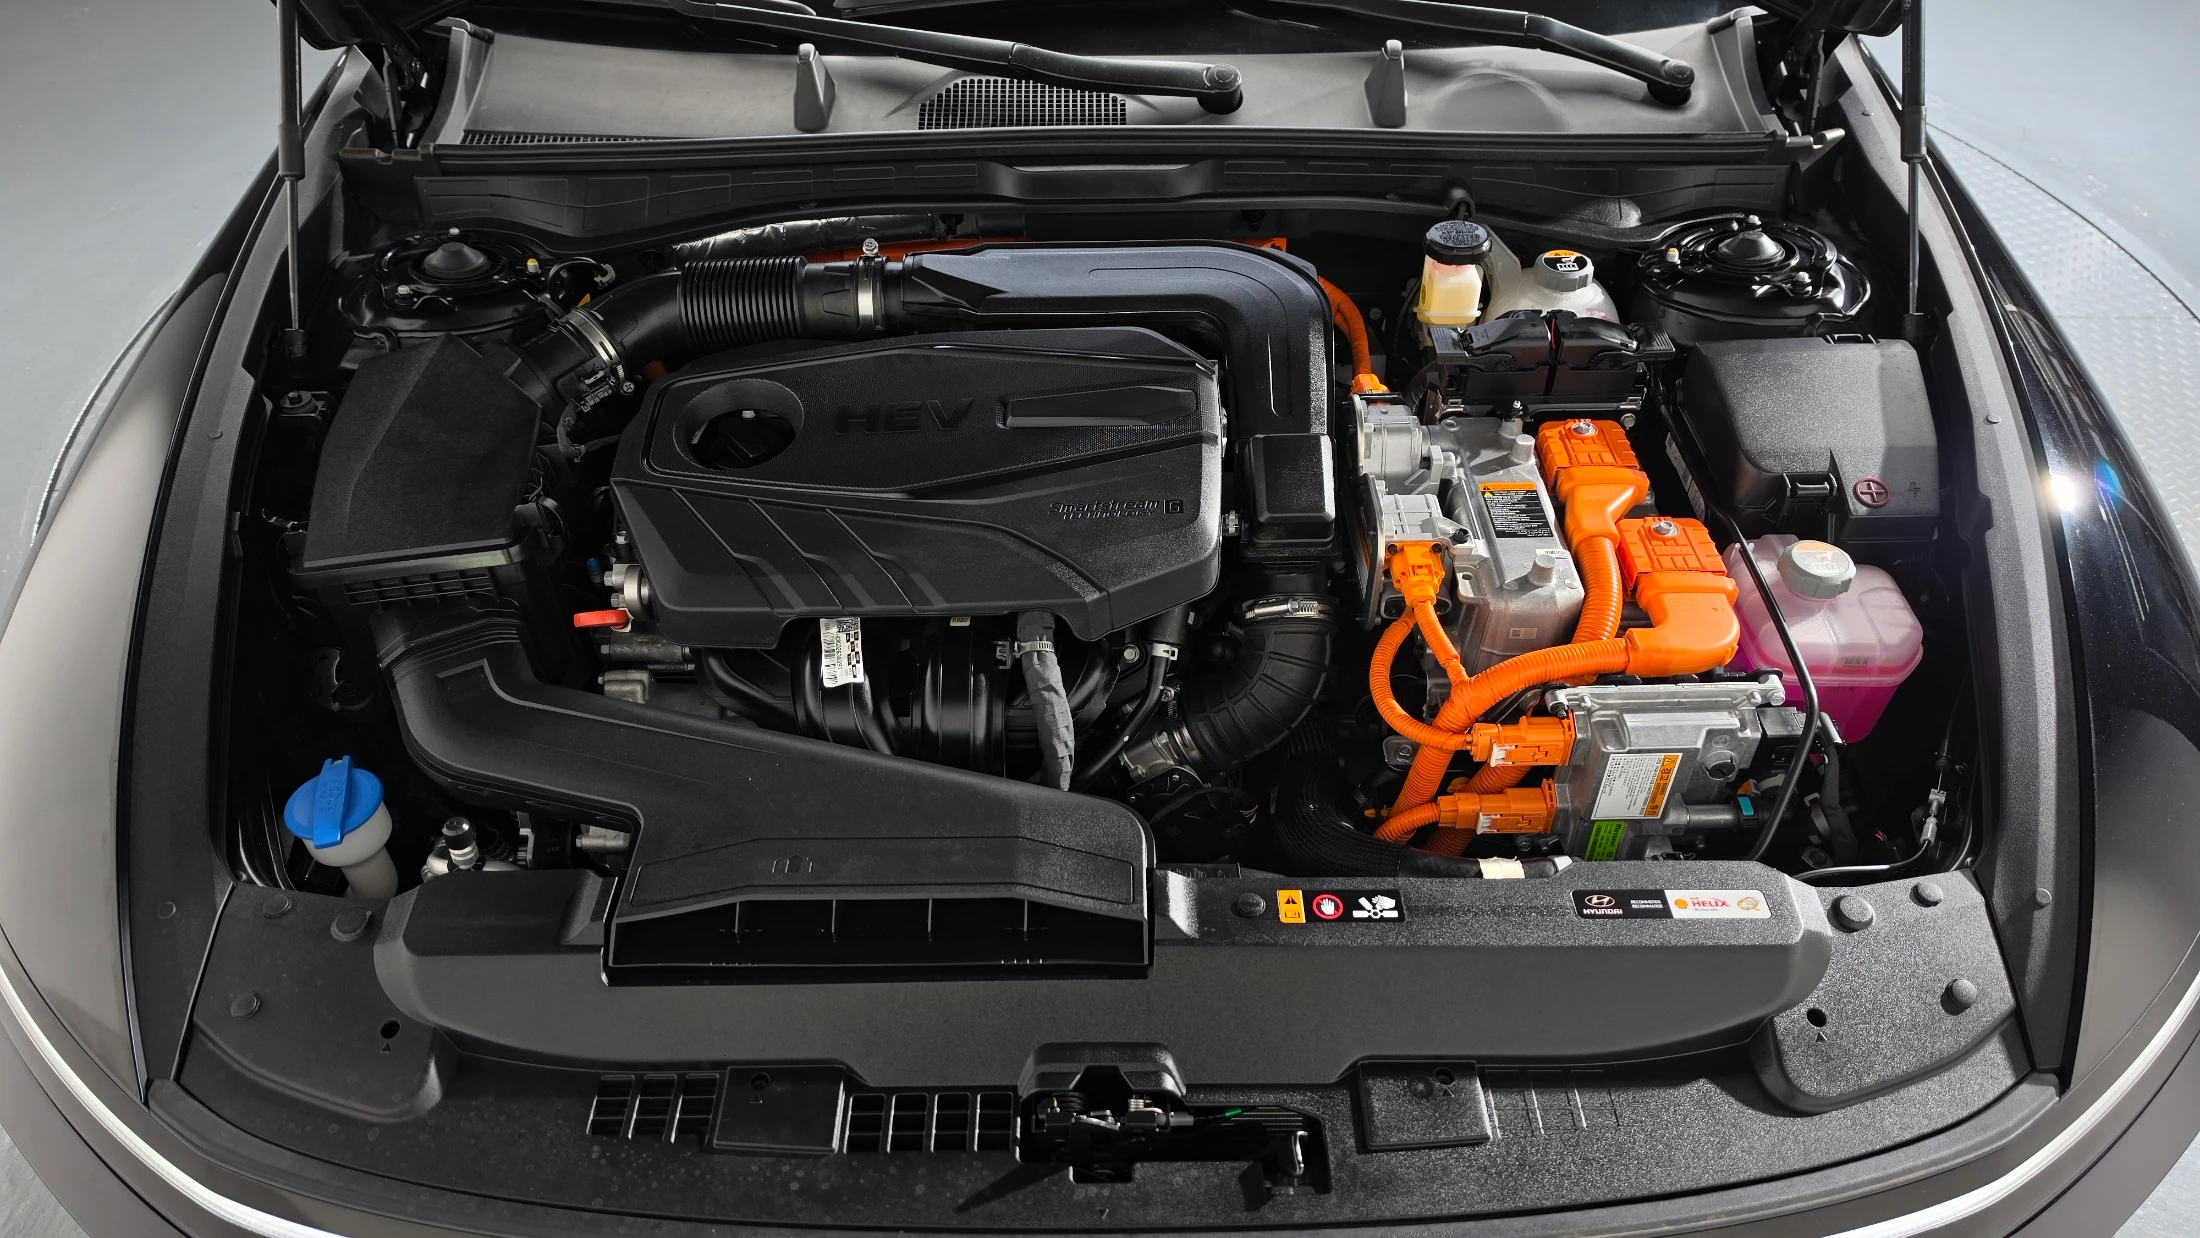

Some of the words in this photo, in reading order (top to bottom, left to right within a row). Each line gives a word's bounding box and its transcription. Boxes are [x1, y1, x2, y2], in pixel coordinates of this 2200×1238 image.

[836, 397, 973, 436] HEV
[1050, 499, 1159, 513] Smartstream
[1844, 657, 1869, 665] MAX
